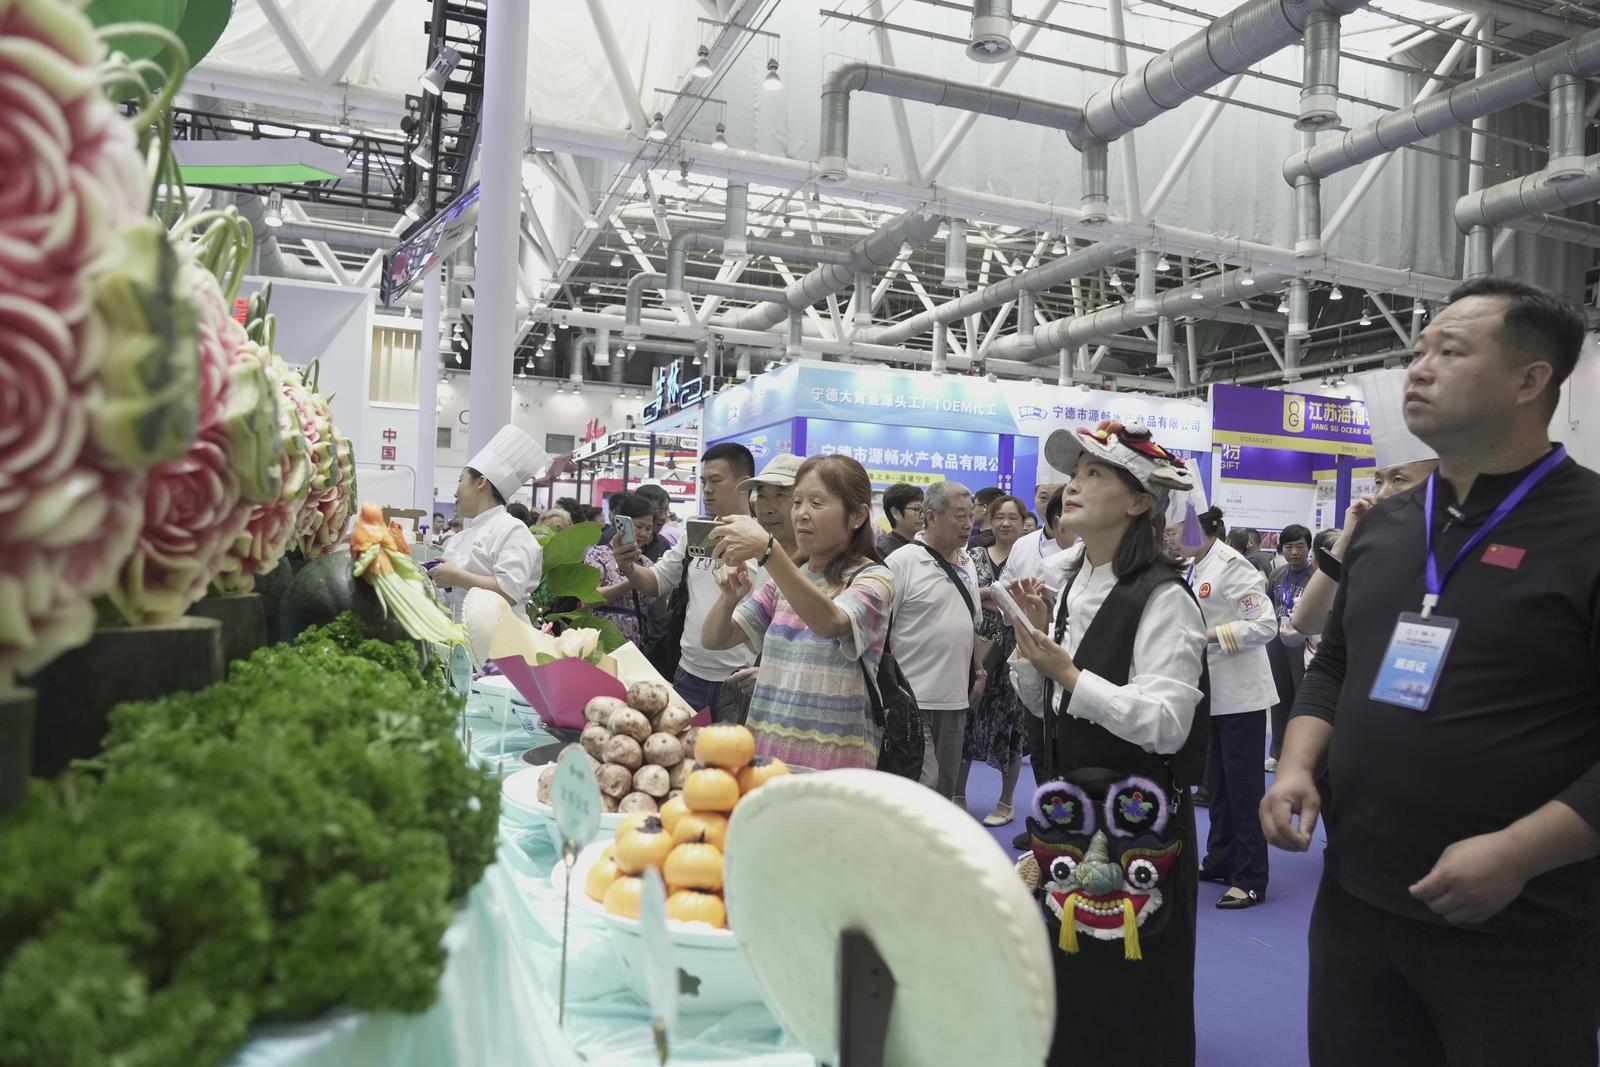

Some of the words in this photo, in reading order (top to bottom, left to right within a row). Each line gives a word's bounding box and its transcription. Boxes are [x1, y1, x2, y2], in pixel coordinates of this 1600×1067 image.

[1053, 406, 1200, 432] 宁德市源畅水产食品有限公司
[1311, 423, 1328, 431] JIANG
[820, 443, 1015, 473] 宁德市源畅水产食品有限公
[1220, 461, 1240, 470] GIFT
